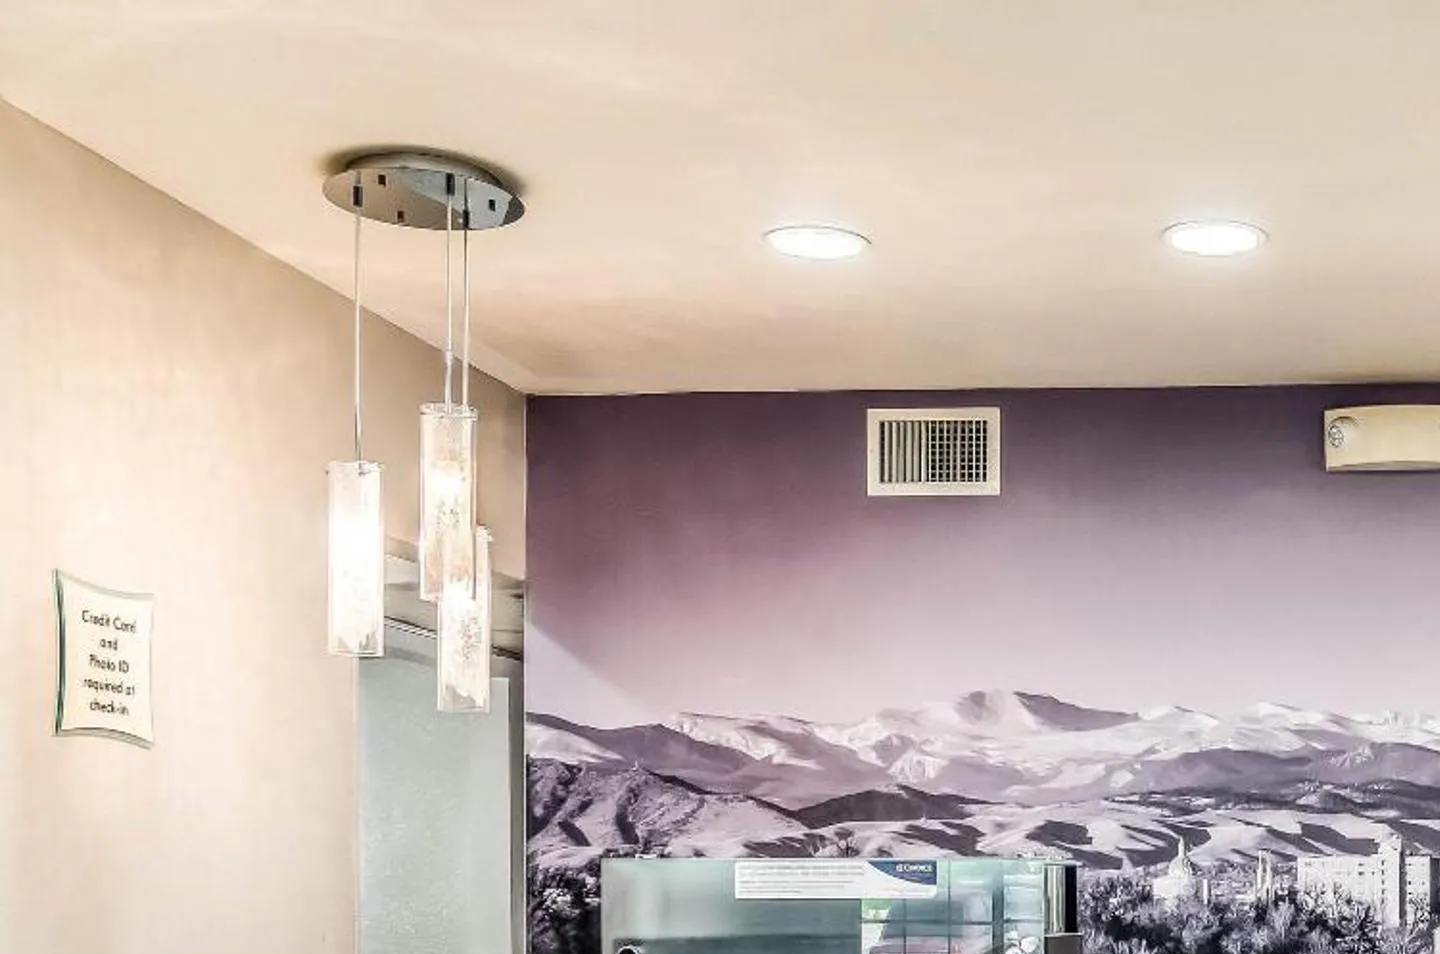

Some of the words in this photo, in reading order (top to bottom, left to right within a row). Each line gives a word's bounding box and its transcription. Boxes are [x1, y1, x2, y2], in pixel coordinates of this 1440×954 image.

[81, 610, 110, 626] Credit
[113, 617, 137, 633] Card
[100, 638, 118, 651] and
[89, 654, 116, 671] Photo
[118, 659, 130, 674] ID
[83, 677, 124, 695] required
[125, 685, 135, 696] at
[89, 700, 129, 716] check-in
